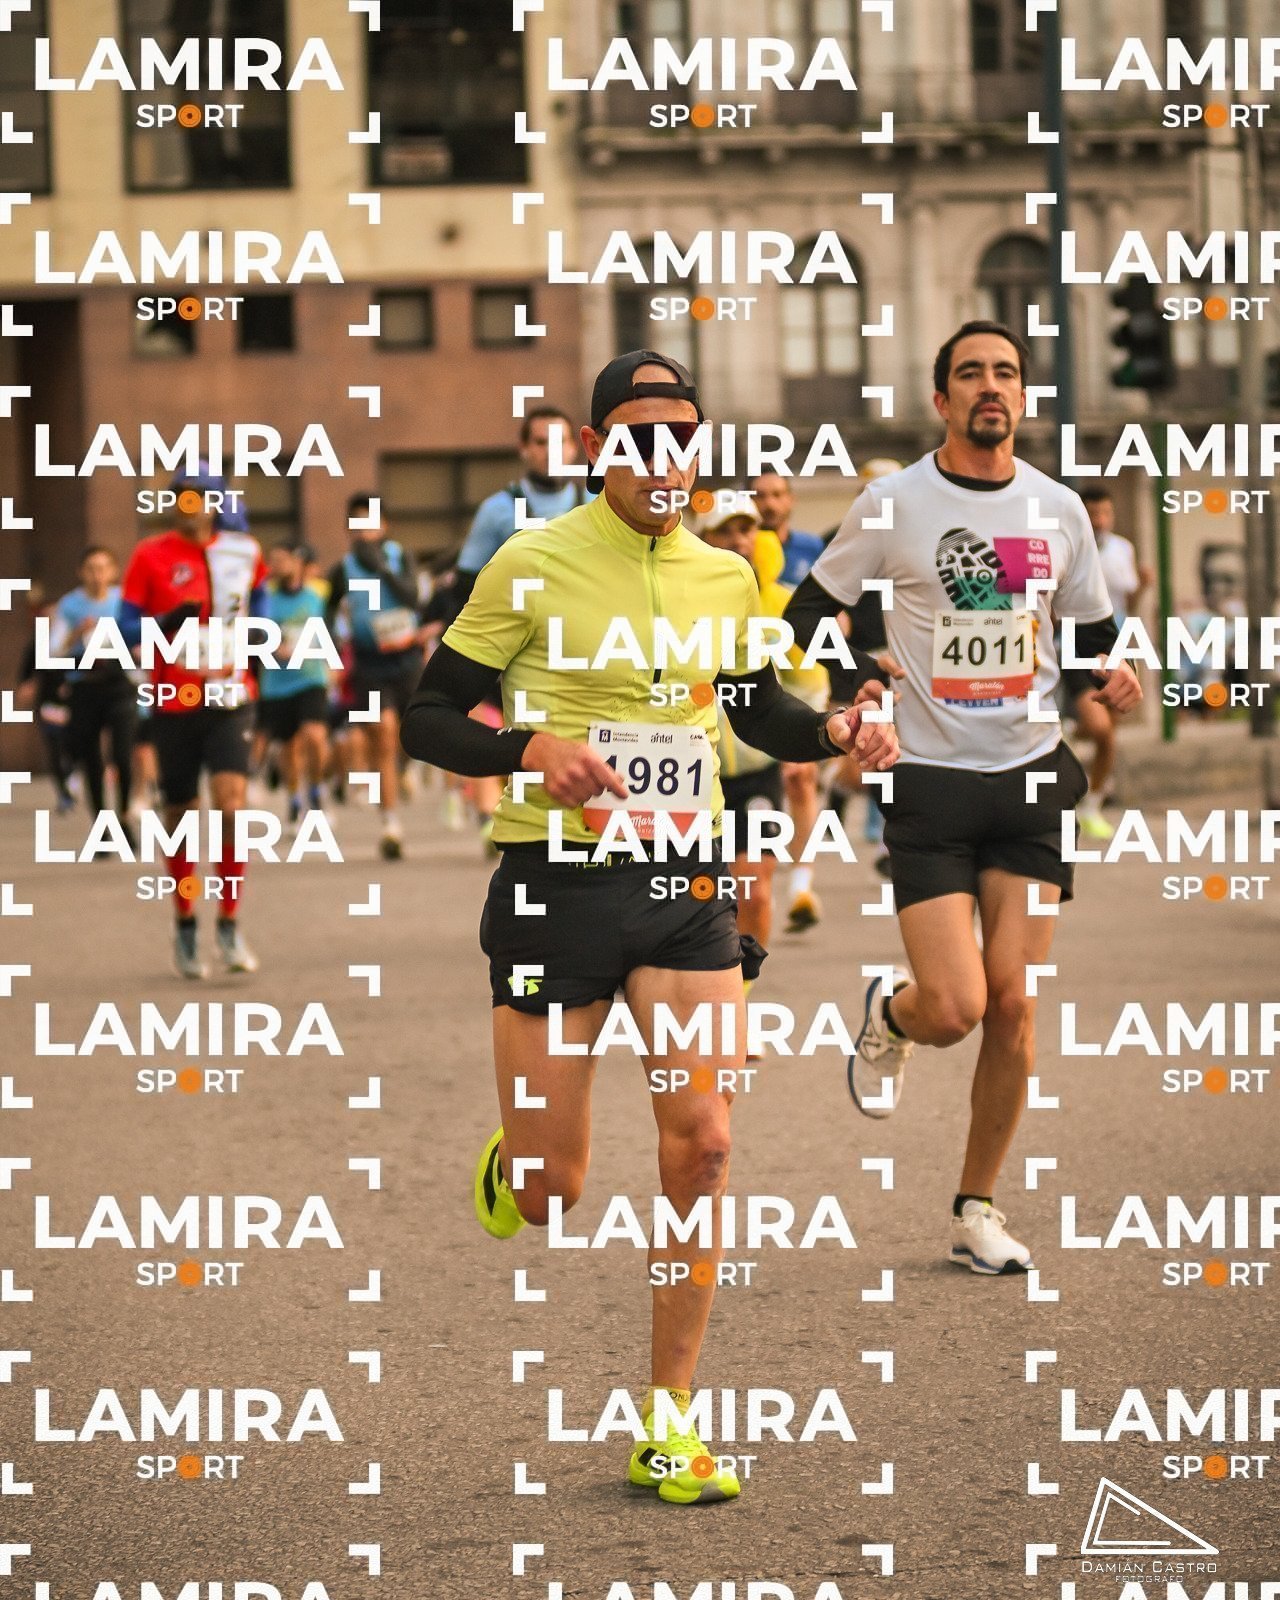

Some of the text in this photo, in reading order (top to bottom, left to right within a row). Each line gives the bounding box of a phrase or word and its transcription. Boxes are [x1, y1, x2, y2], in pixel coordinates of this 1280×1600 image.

[1029, 539, 1044, 551] CO
[1027, 552, 1050, 565] RRE
[942, 634, 1025, 666] 4011
[650, 732, 673, 744] antel
